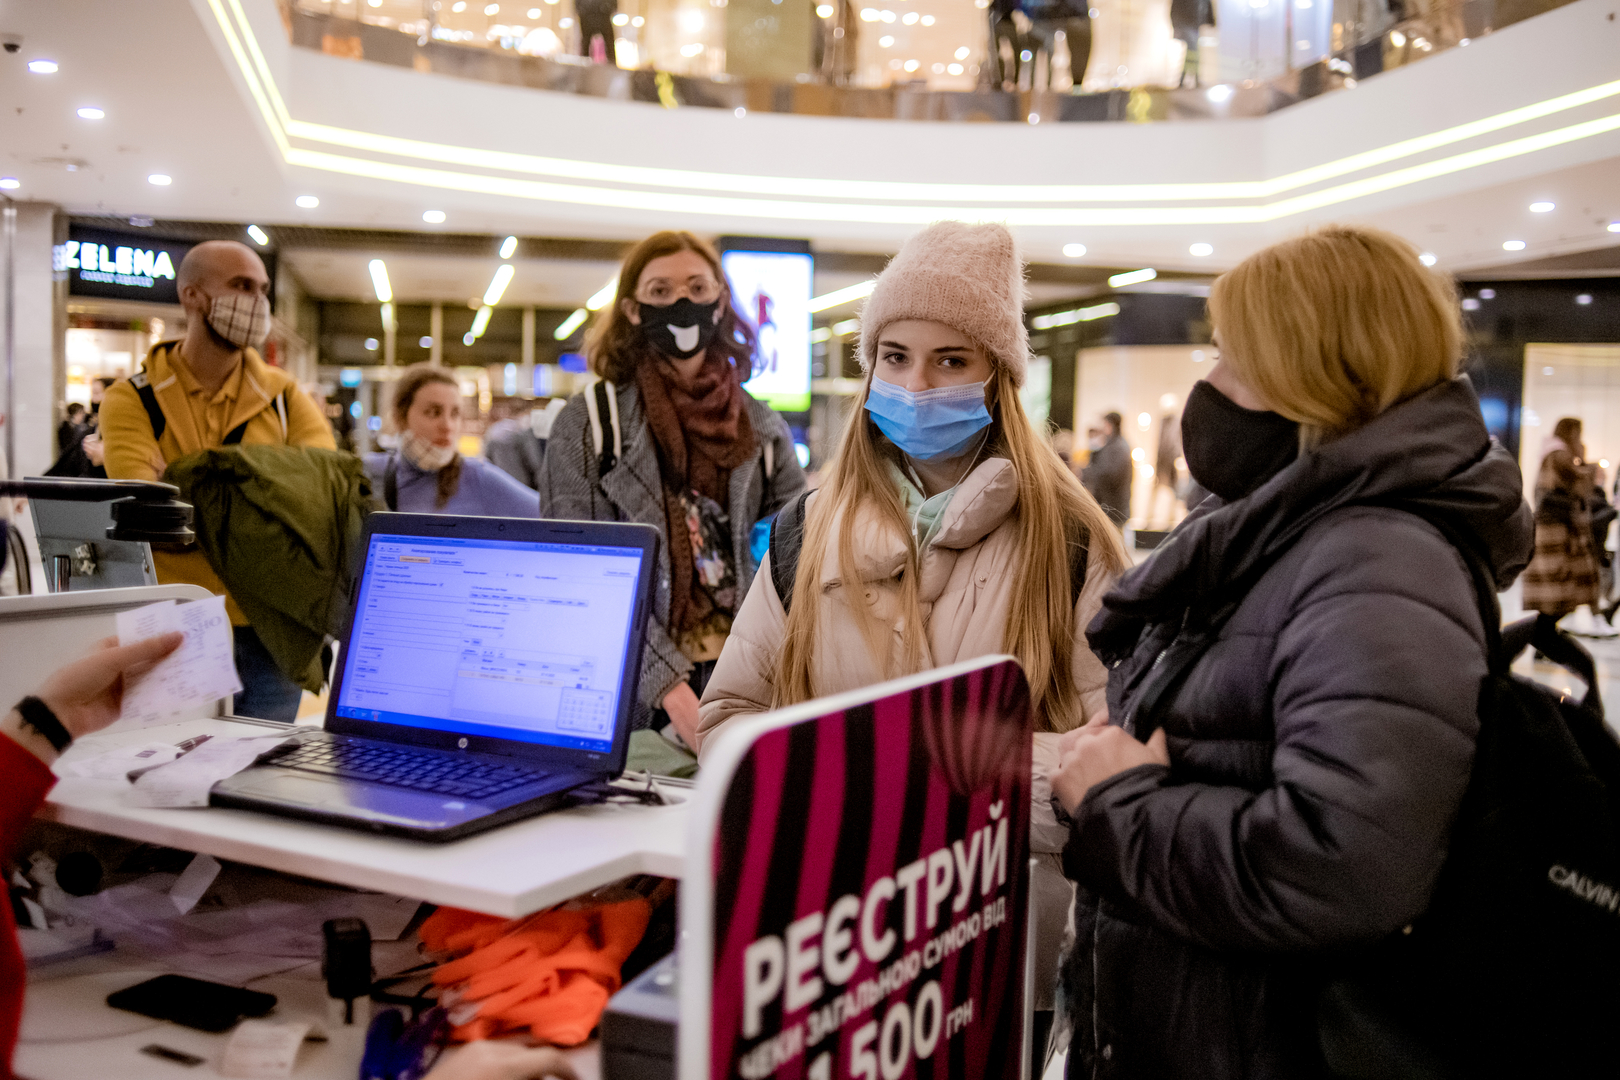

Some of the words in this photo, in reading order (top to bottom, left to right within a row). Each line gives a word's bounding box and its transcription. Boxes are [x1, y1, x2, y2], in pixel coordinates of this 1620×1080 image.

[65, 240, 176, 280] ZELENA
[1548, 864, 1619, 912] CALVIN
[743, 800, 1008, 1040] РЕЄСТРУЙ
[807, 950, 921, 1047] ЗАГАЛЬНОЮ
[923, 913, 981, 969] СУМОЮ
[983, 896, 1006, 932] ВІД
[947, 998, 974, 1040] ГРН
